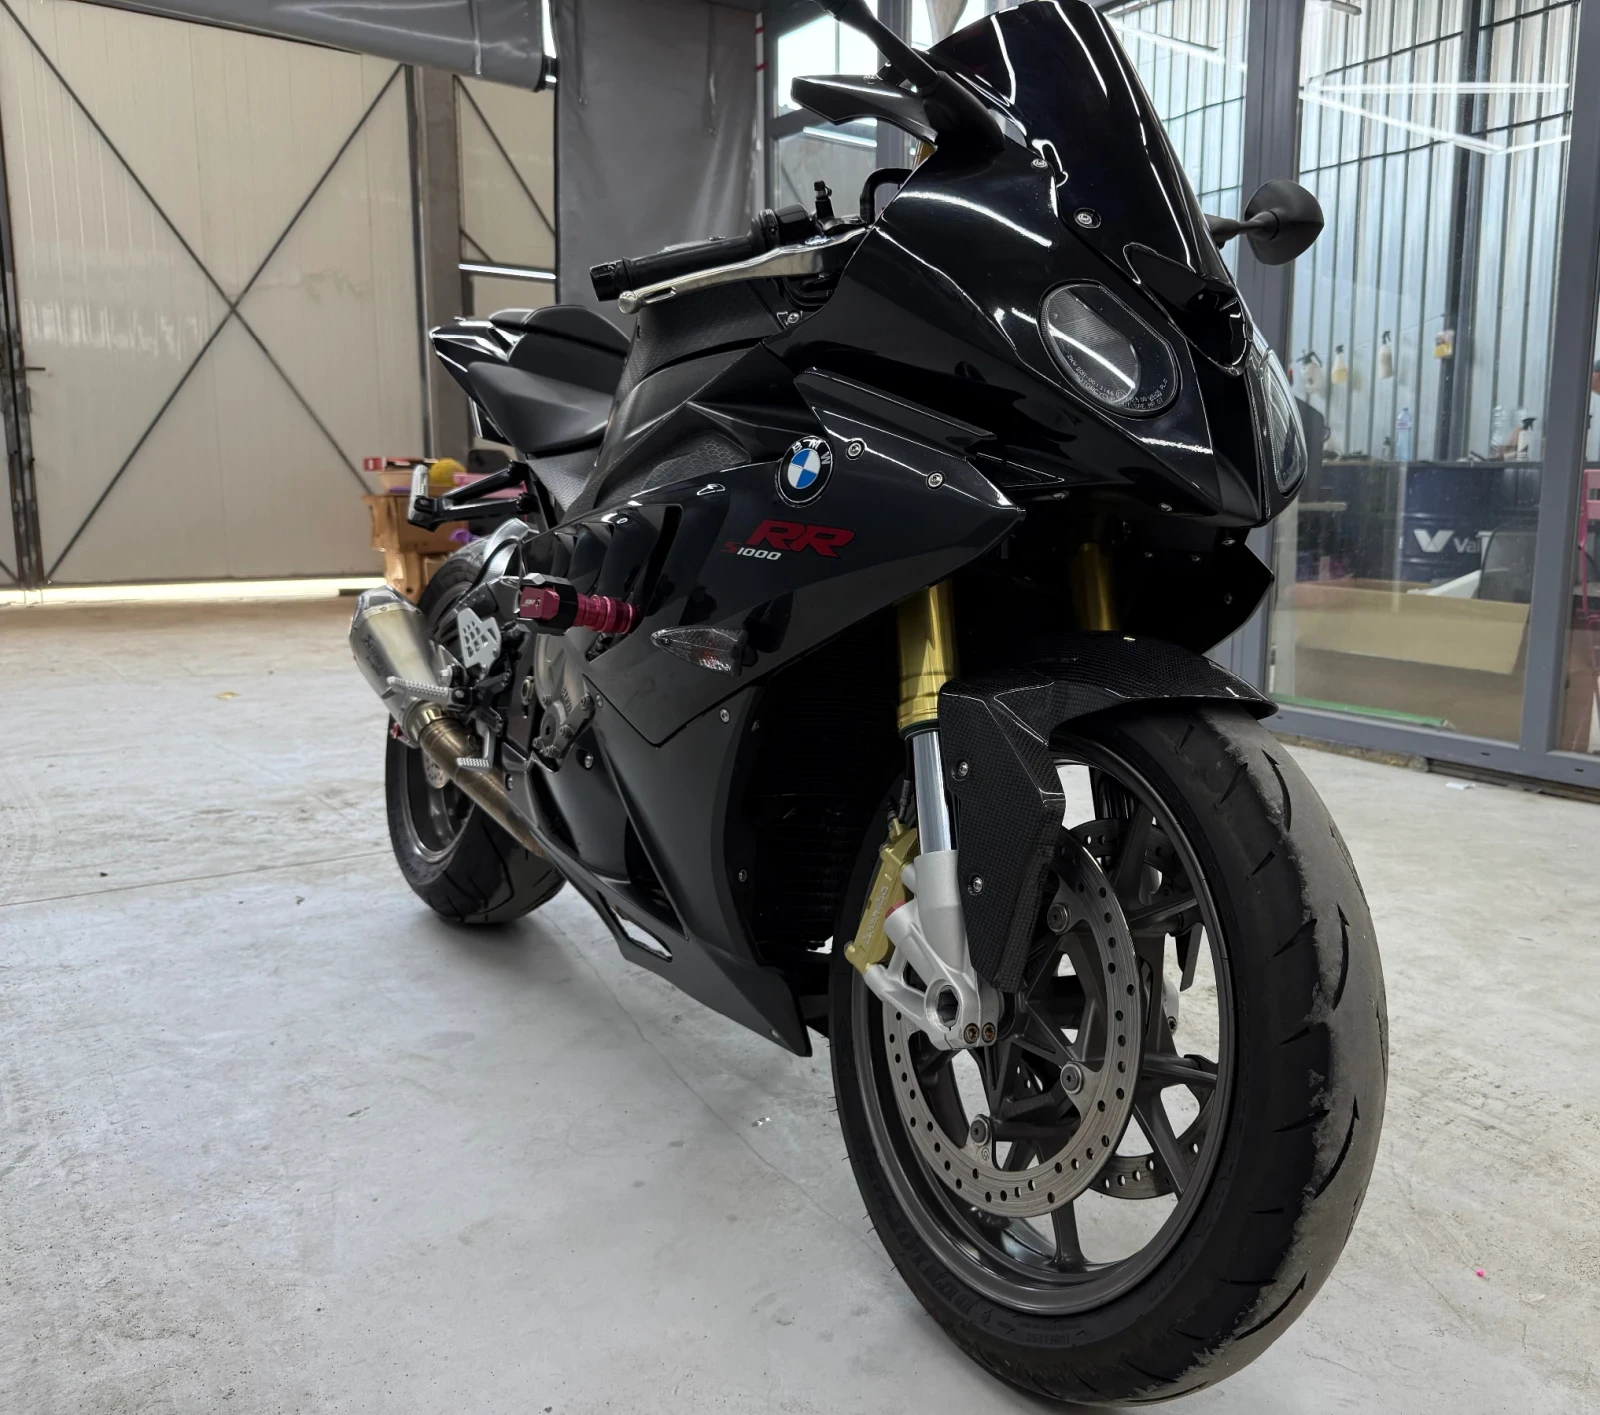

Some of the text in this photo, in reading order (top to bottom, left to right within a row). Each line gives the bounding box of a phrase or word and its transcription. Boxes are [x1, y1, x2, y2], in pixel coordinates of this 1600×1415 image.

[792, 438, 832, 466] BMW
[721, 541, 783, 561] S1000
[746, 519, 856, 558] RR
